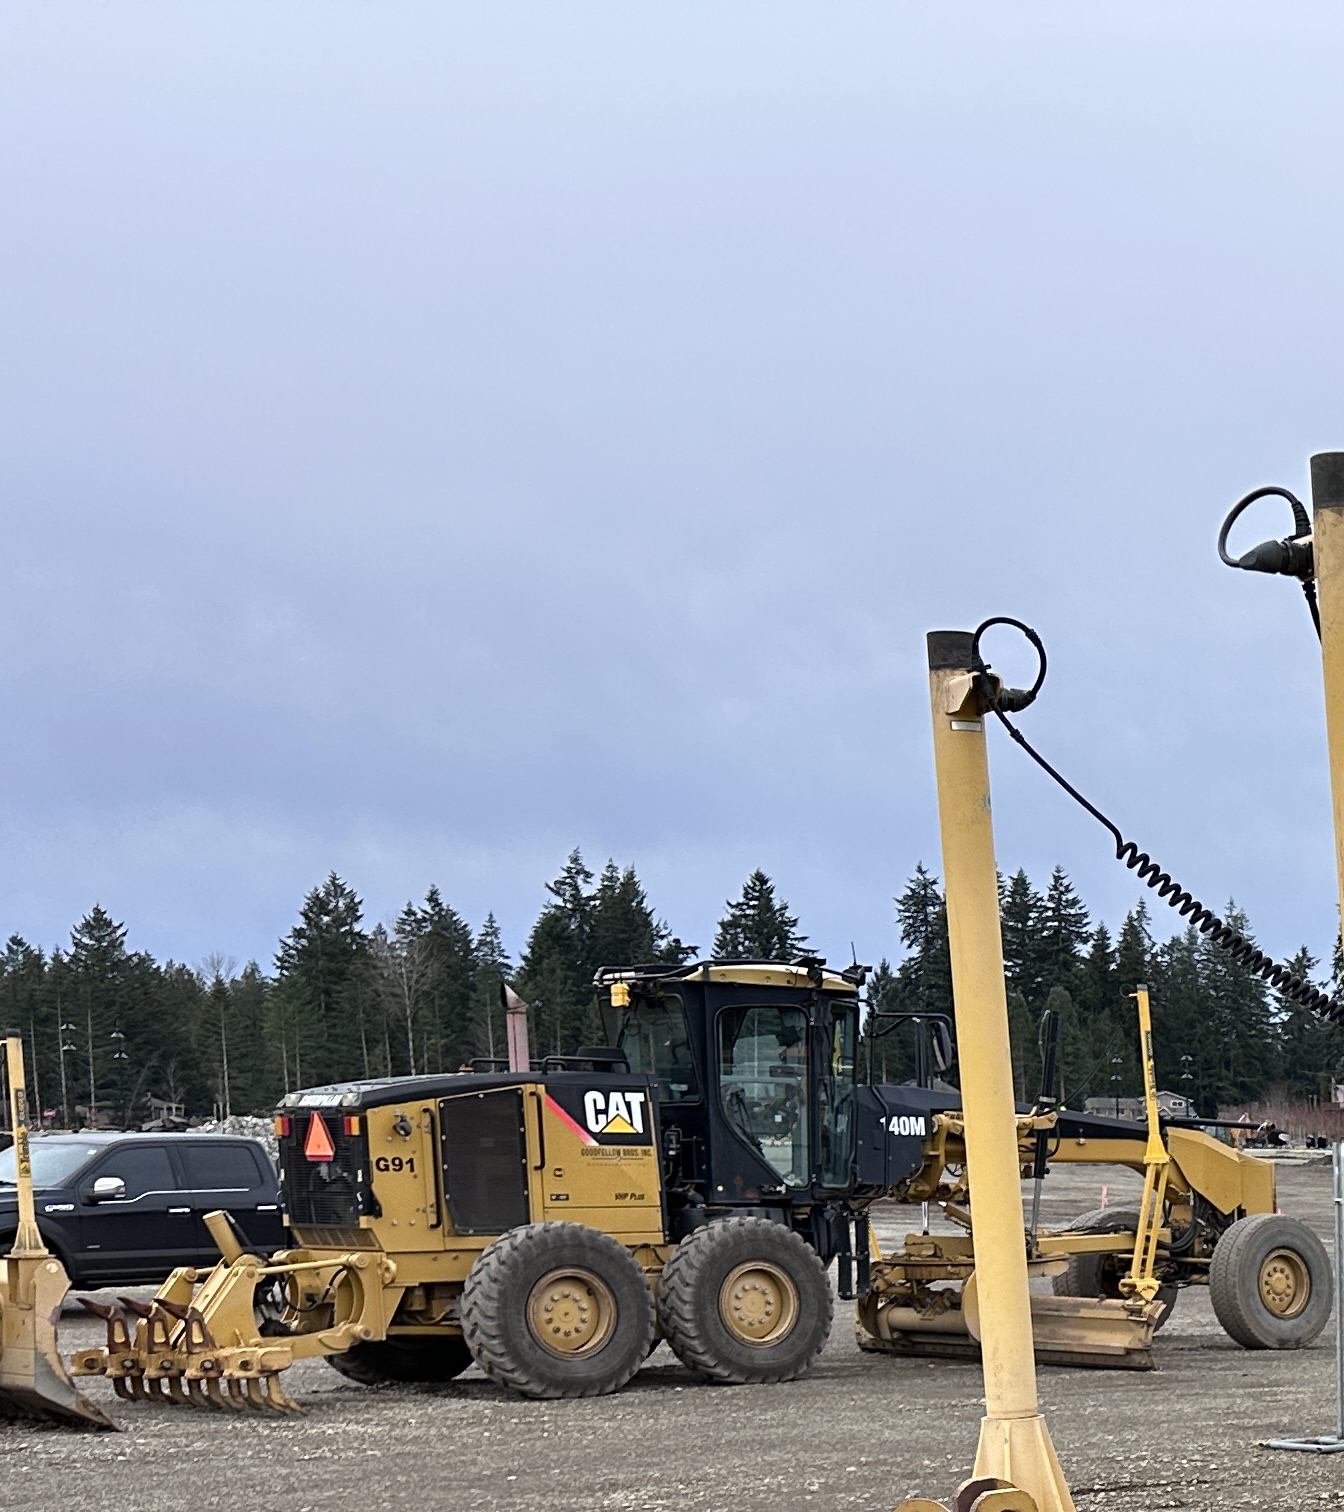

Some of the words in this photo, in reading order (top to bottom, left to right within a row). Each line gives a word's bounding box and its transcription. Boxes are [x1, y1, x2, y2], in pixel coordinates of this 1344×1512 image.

[583, 1090, 646, 1134] CAT
[879, 1115, 926, 1136] 140M
[375, 1156, 416, 1173] G91
